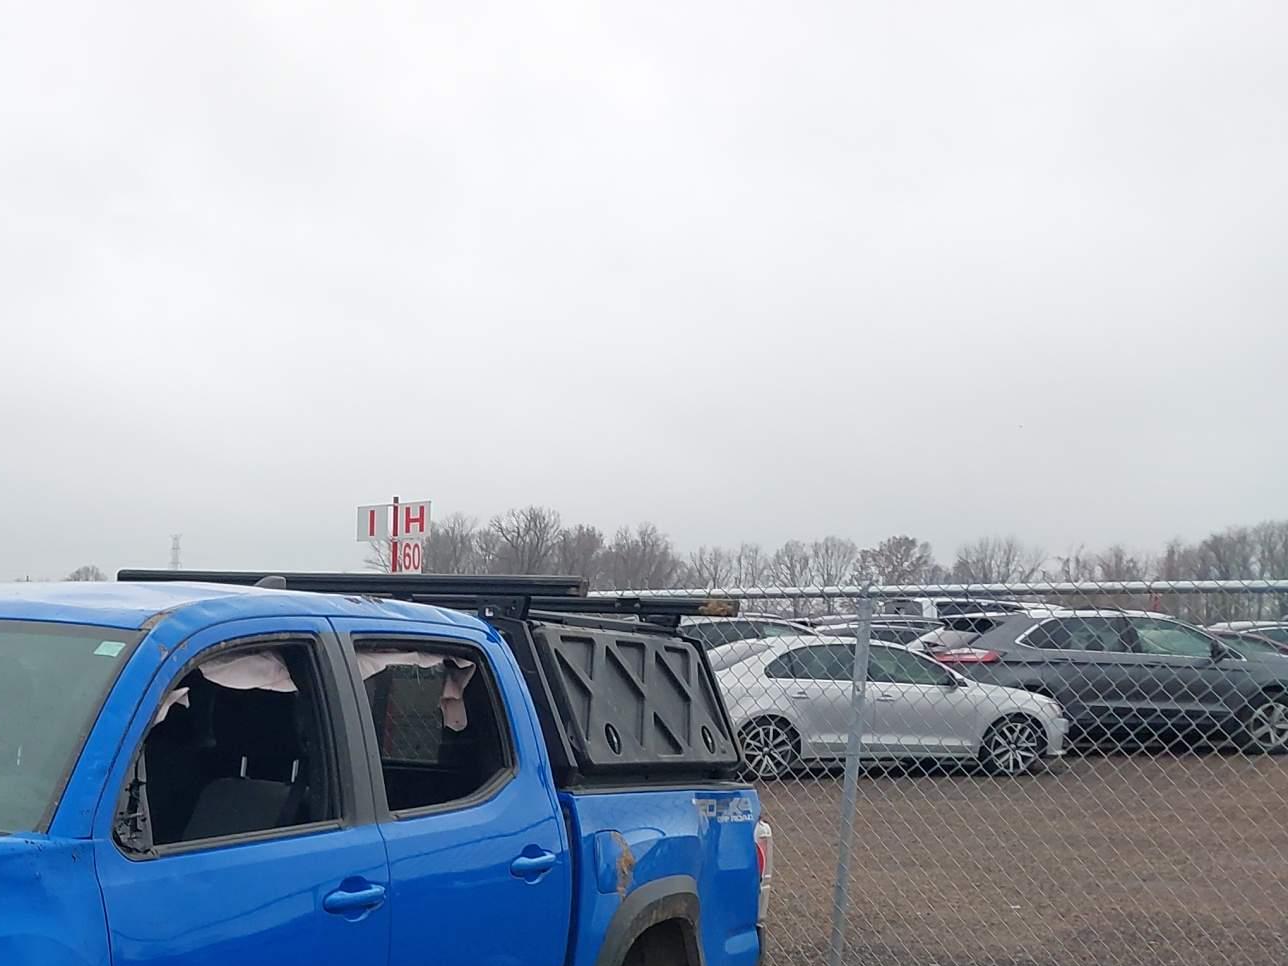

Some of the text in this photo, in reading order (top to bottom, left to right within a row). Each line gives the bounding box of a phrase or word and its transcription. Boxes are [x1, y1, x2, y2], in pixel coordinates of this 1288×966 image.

[369, 509, 376, 537] I
[405, 505, 425, 534] H
[403, 542, 421, 570] 60
